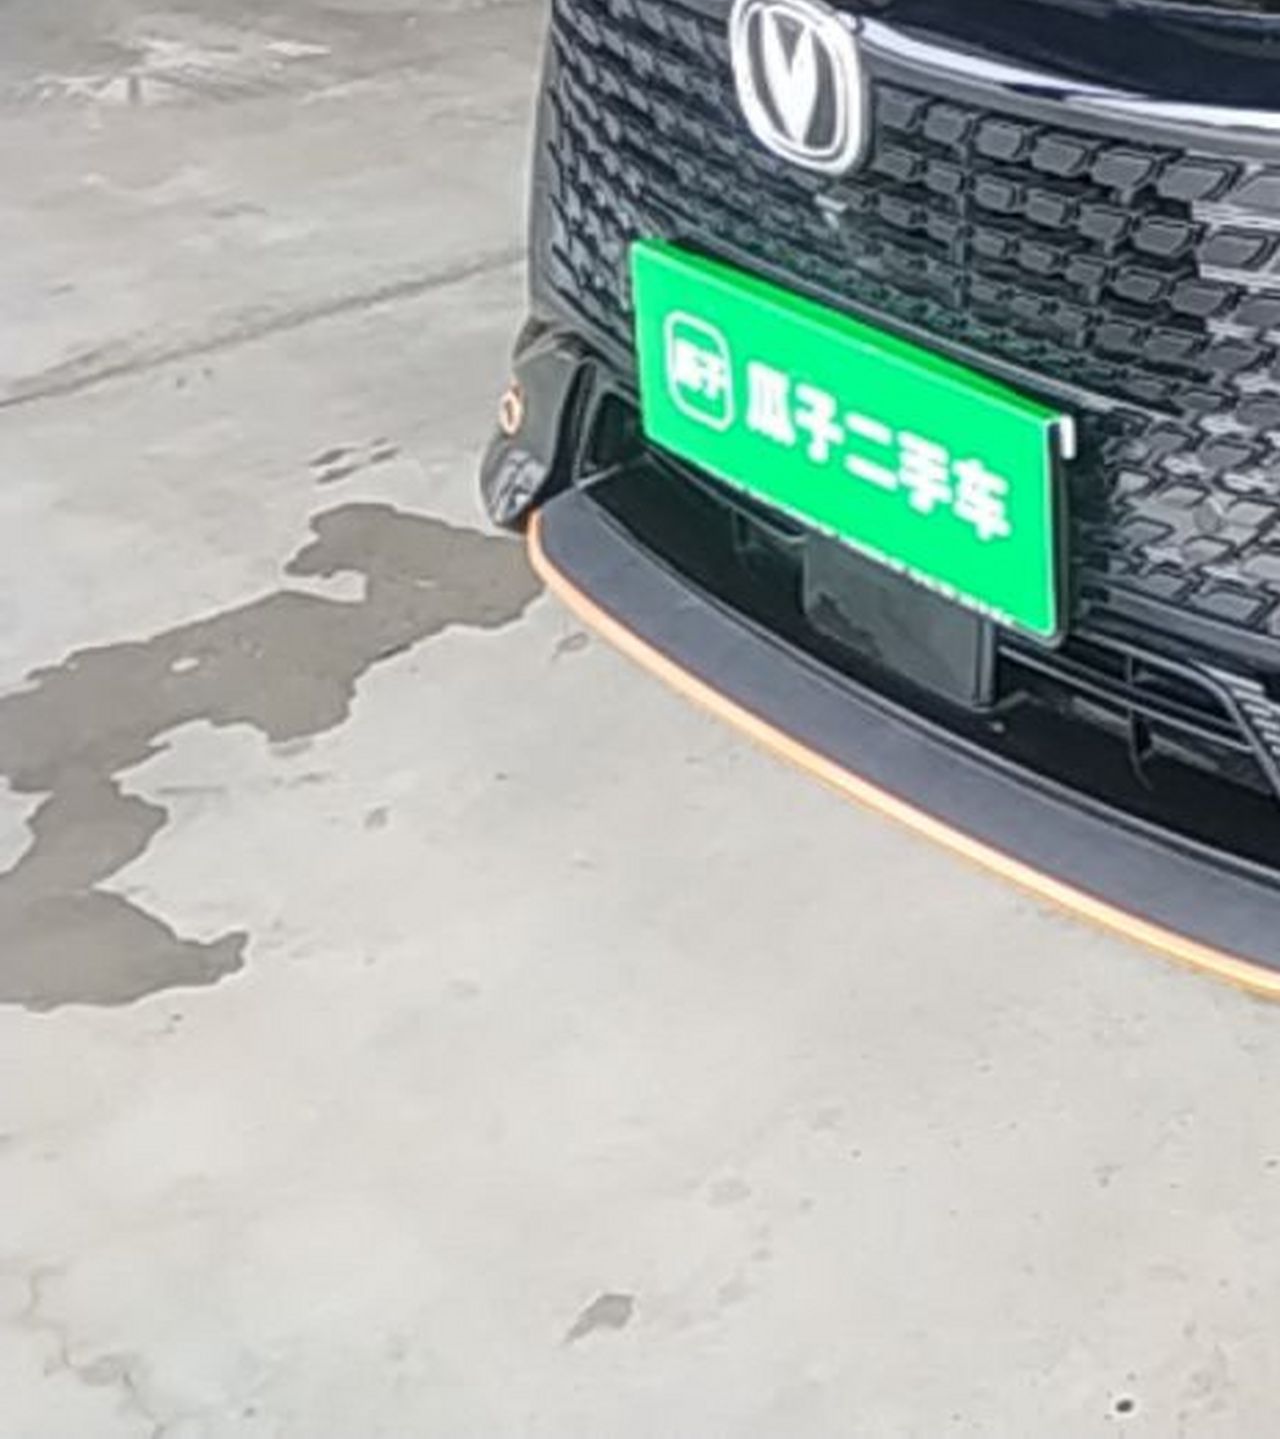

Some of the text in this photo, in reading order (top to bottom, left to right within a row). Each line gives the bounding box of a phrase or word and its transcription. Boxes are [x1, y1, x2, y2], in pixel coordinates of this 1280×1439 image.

[745, 360, 1012, 541] 瓜子二手车
